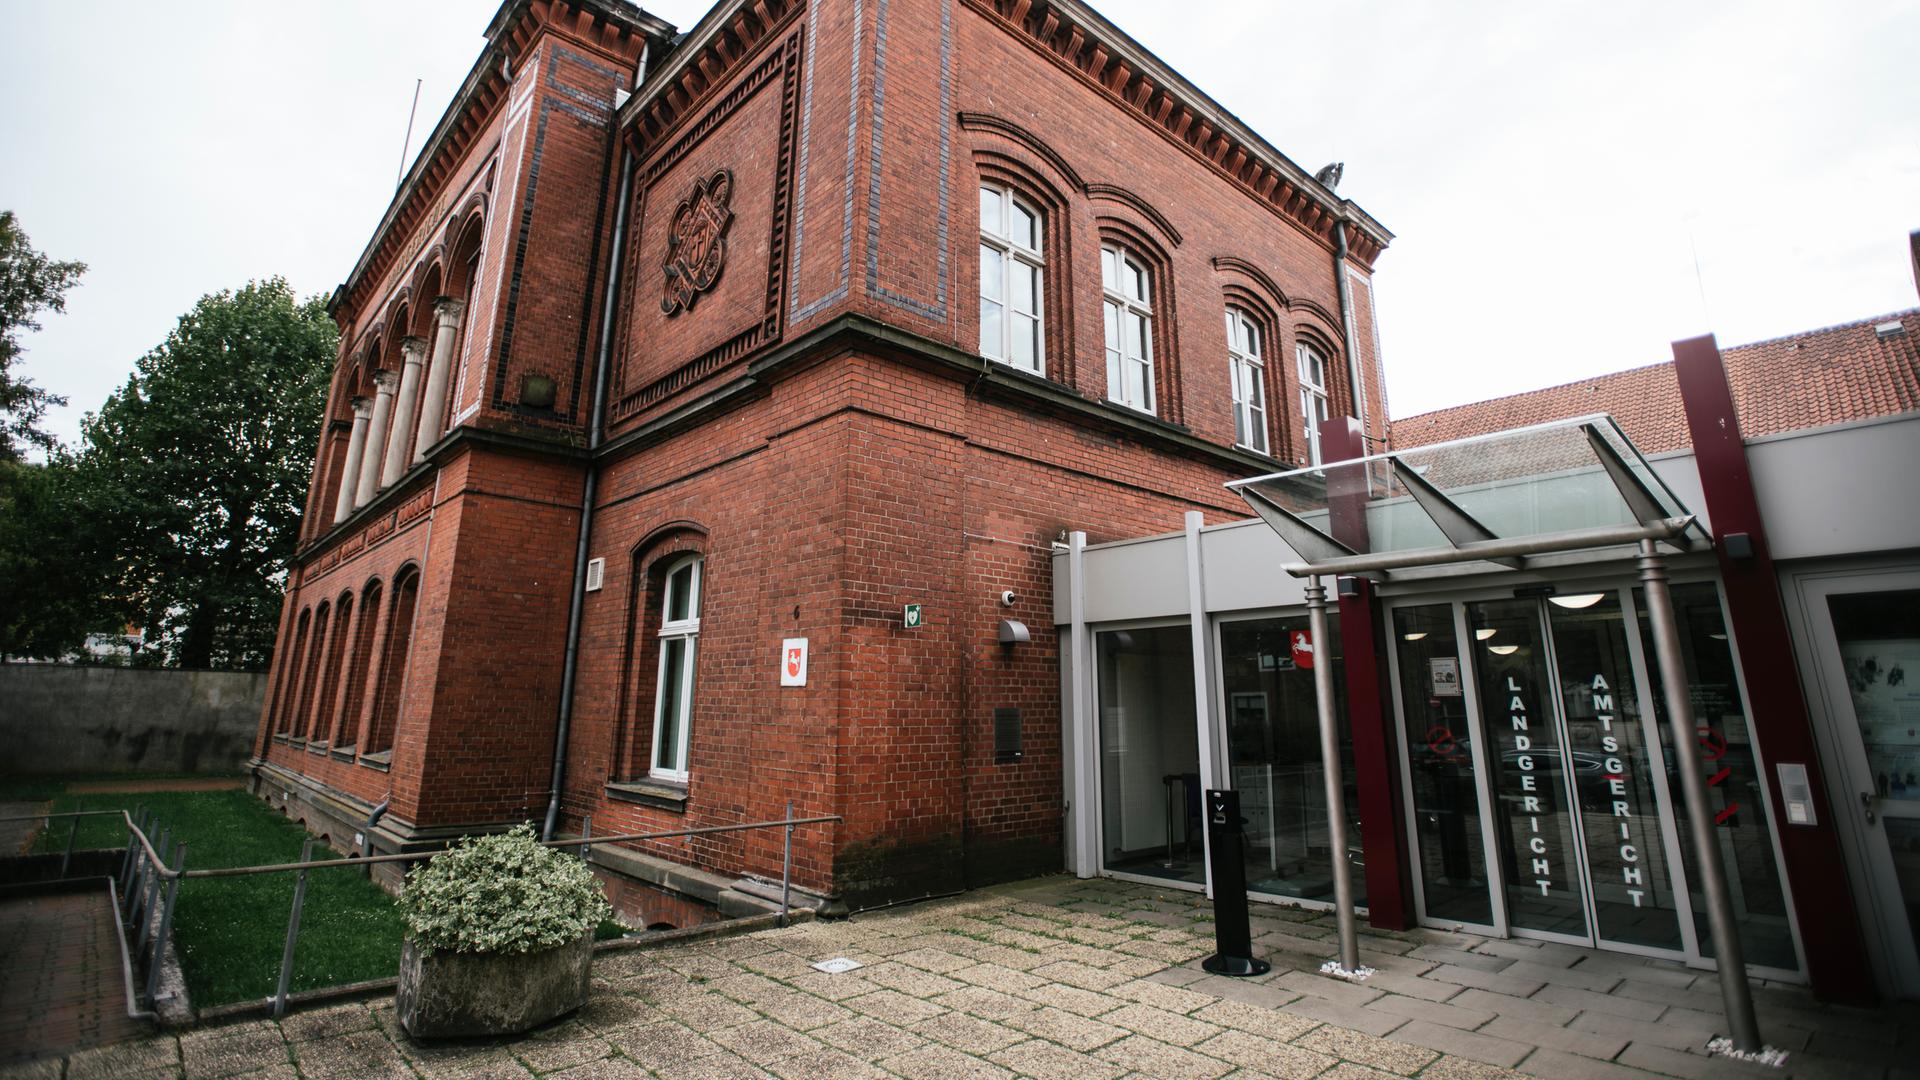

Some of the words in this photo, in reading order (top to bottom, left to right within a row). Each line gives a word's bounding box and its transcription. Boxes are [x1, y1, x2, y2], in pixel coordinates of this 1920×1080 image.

[793, 605, 800, 620] 6
[1507, 677, 1551, 896] LANDGERICHT
[1592, 674, 1644, 907] AMTSGERICHT
